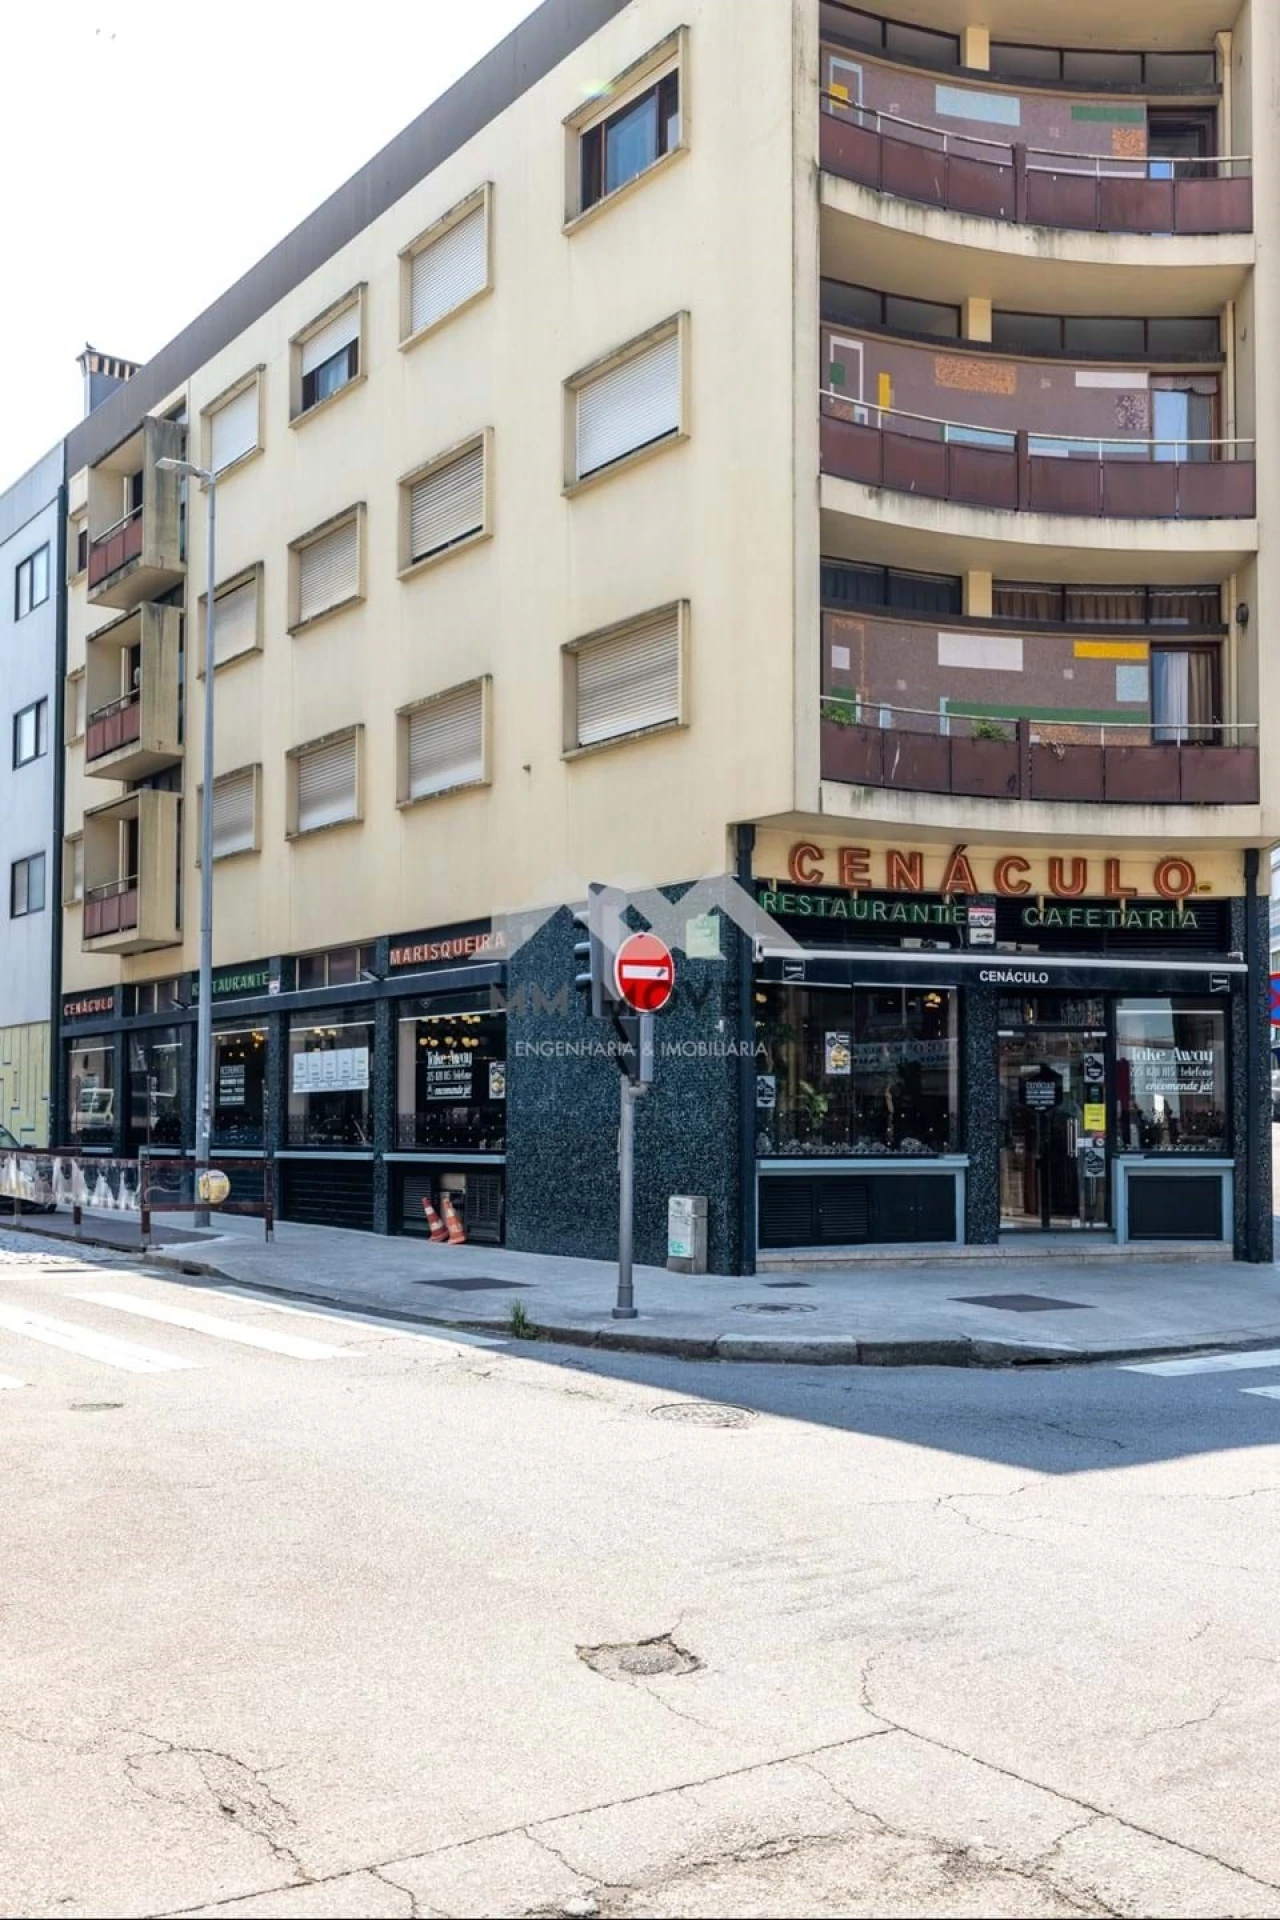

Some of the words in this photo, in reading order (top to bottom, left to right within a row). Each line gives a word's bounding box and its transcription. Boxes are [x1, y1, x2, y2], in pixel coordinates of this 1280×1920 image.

[788, 843, 1197, 898] CENÁCULO
[761, 890, 967, 924] RESTAURANTE
[1022, 906, 1199, 929] CAFETARIA
[389, 931, 507, 966] MARISQUEIRA
[979, 968, 1049, 984] CENÁCULO
